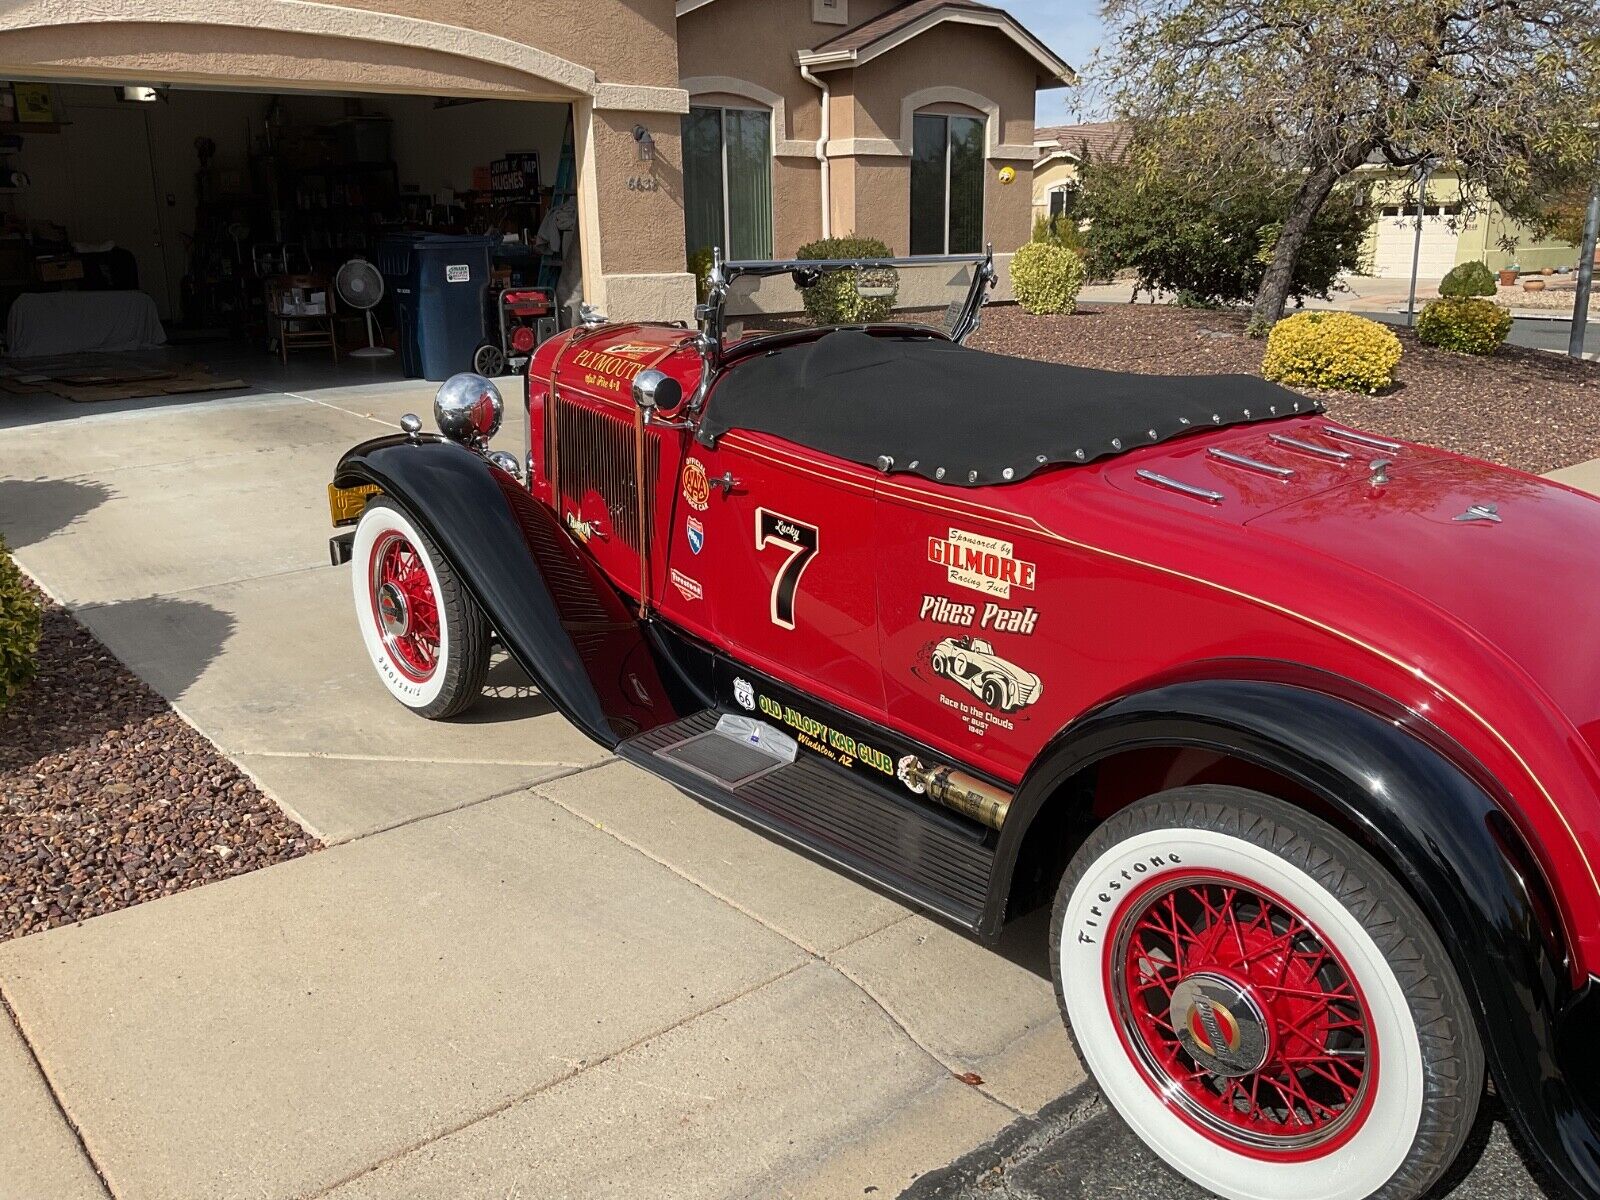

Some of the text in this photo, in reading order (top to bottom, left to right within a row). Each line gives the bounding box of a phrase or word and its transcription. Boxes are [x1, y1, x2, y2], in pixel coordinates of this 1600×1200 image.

[492, 171, 524, 190] HUGHES
[685, 457, 706, 476] OFFICIAL
[698, 502, 710, 512] CAR
[774, 519, 800, 543] Lucky
[949, 530, 1011, 560] Sponsored by
[754, 506, 820, 631] 7
[929, 538, 1034, 588] GILMORE
[949, 570, 1009, 595] Racing Fuel
[919, 594, 1039, 635] Pikes Peak
[957, 657, 966, 672] 7
[738, 692, 751, 706] 66
[939, 693, 1014, 731] Race to the Clouds
[758, 694, 783, 721] OLD
[783, 706, 828, 744] JALOPY
[828, 727, 859, 759] KAR
[857, 742, 894, 776] CLUB
[961, 715, 989, 730] or BUST
[797, 732, 853, 768] Windslow, AZ
[1077, 853, 1183, 944] Firestone
